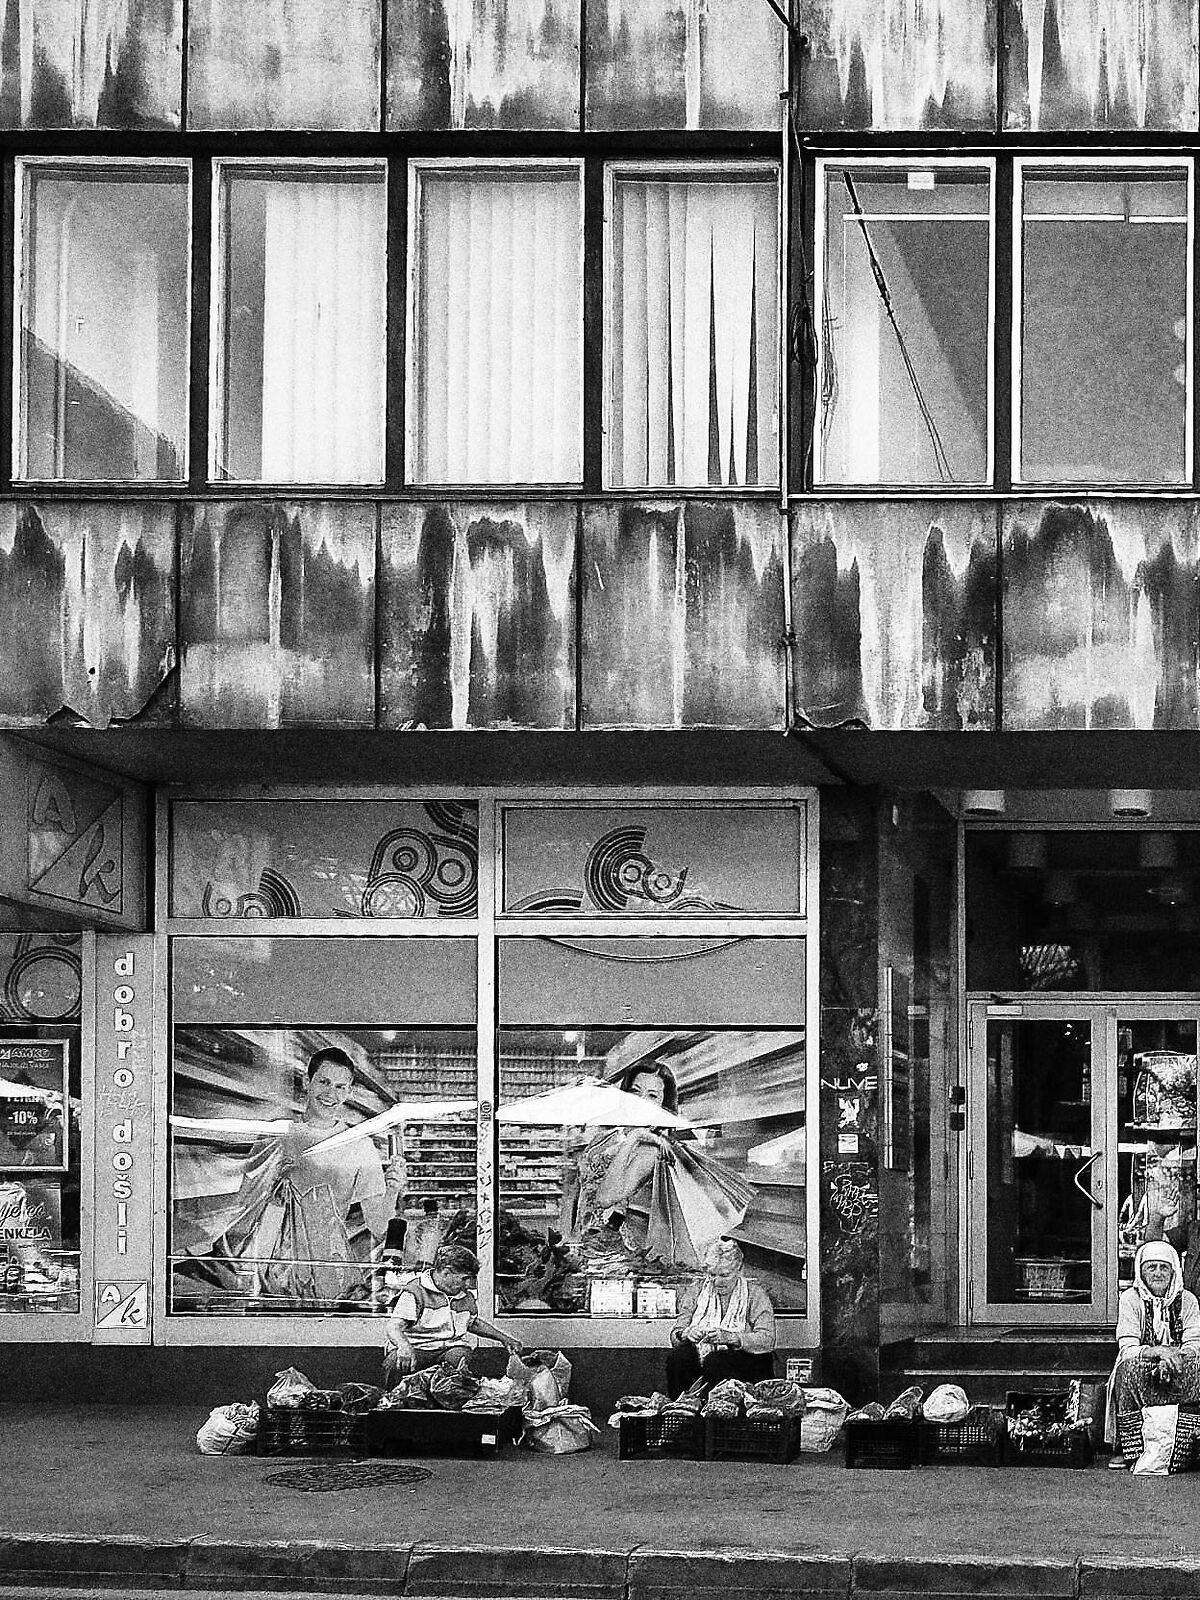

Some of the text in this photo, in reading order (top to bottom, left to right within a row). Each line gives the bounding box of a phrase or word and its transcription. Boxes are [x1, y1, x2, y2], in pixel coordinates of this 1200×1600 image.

[113, 952, 135, 1088] dobro
[8, 1110, 38, 1125] -10%
[112, 1119, 134, 1255] došli
